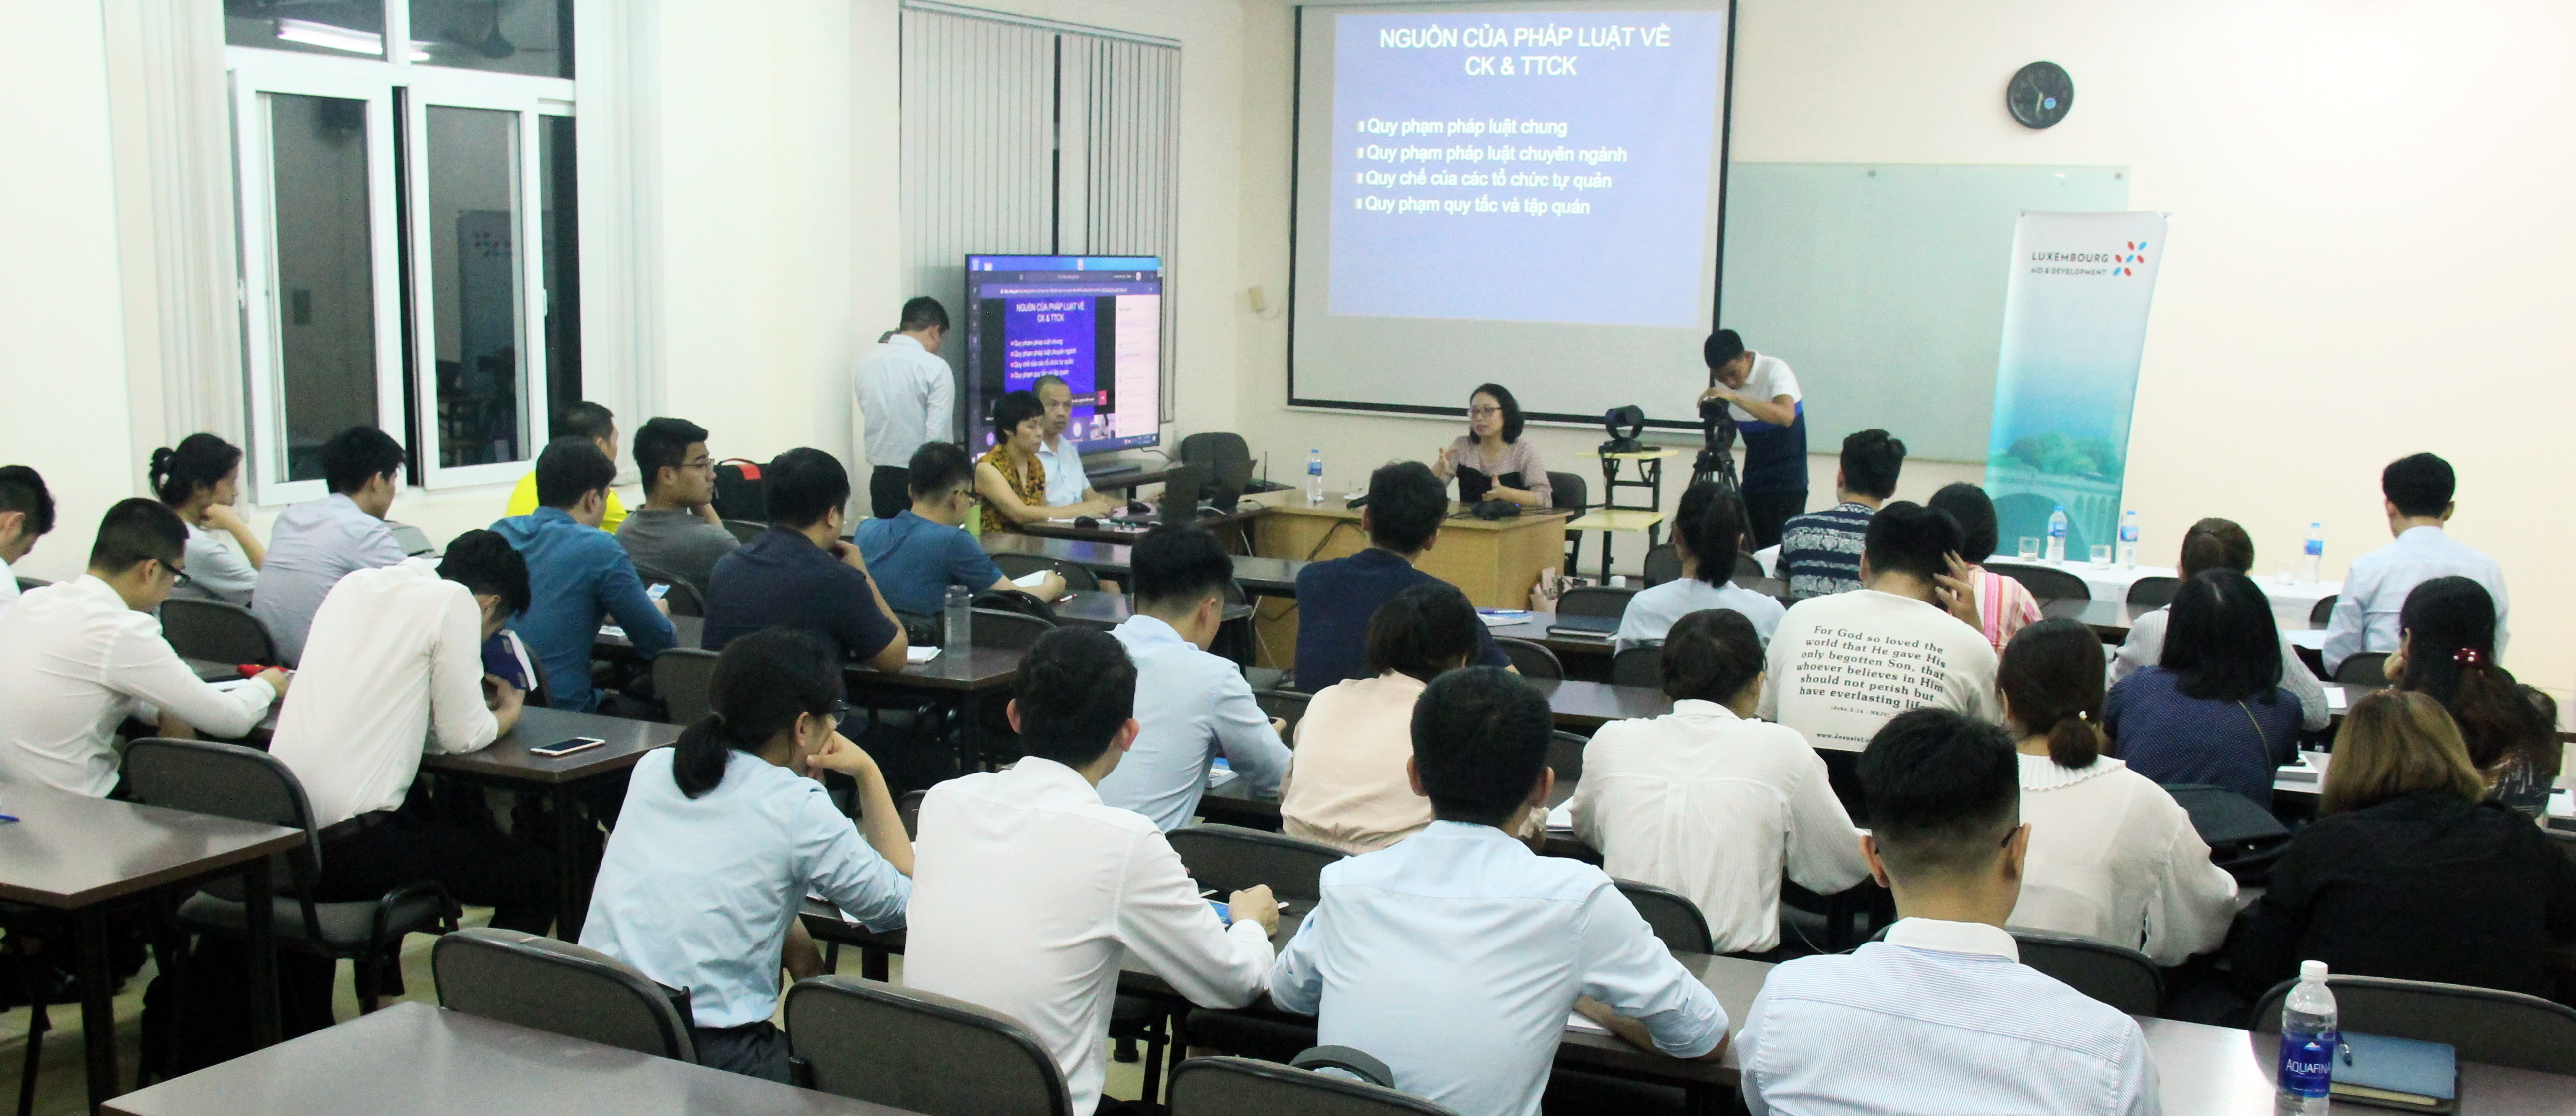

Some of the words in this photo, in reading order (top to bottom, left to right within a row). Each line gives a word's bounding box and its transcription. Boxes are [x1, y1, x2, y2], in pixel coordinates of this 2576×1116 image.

[1463, 24, 1509, 48] CỦA
[1514, 23, 1573, 47] PHÁP
[1578, 24, 1636, 50] LUẬT
[1465, 56, 1496, 76] CK
[1500, 56, 1515, 76] &
[1520, 55, 1578, 76] TTCK
[1367, 118, 1398, 137] Quy
[1401, 118, 1443, 137] phạm
[1447, 118, 1485, 137] pháp
[1489, 118, 1517, 137] luật
[1520, 118, 1568, 138] chung
[1367, 144, 1397, 163] Quy
[1400, 145, 1442, 163] phạm
[1446, 144, 1484, 164] pháp
[1487, 145, 1516, 164] luật
[1519, 145, 1574, 165] chuyên
[1366, 170, 1396, 189] Quy
[1399, 167, 1427, 185] chế
[1430, 169, 1458, 186] của
[1461, 171, 1488, 186] các
[1492, 168, 1507, 186] tổ
[1510, 172, 1549, 187] chức
[1552, 173, 1570, 191] tự
[1573, 171, 1612, 191] quản
[1365, 195, 1395, 214] Quy
[1398, 196, 1440, 214] phạm
[1444, 199, 1471, 215] quy
[1524, 197, 1548, 216] tập
[1551, 198, 1590, 217] quán
[2032, 252, 2109, 263] LUXEMBOURG
[1814, 625, 1833, 635] For
[1838, 628, 1863, 640] God
[1886, 636, 1919, 648] loved
[1924, 643, 1943, 654] the
[1802, 650, 1824, 660] only
[1829, 651, 1883, 666] begotten
[1888, 659, 1915, 672] Son,
[1921, 666, 1945, 680] that
[1806, 638, 1838, 647] world
[1843, 642, 1866, 652] that
[1871, 646, 1889, 655] He
[1892, 650, 1921, 660] gave
[1926, 654, 1946, 668] His
[1797, 662, 1842, 672] whoever
[1847, 665, 1898, 680] believes
[1903, 674, 1915, 684] in
[1920, 677, 1943, 693] Him
[1800, 674, 1839, 685] should
[1844, 680, 1865, 688] not
[1869, 683, 1908, 695] perish
[1914, 688, 1935, 702] but
[1799, 686, 1825, 696] have
[1830, 690, 1900, 708] everlasting
[1906, 699, 1921, 710] lif
[2285, 1059, 2331, 1075] AQUAFINA
